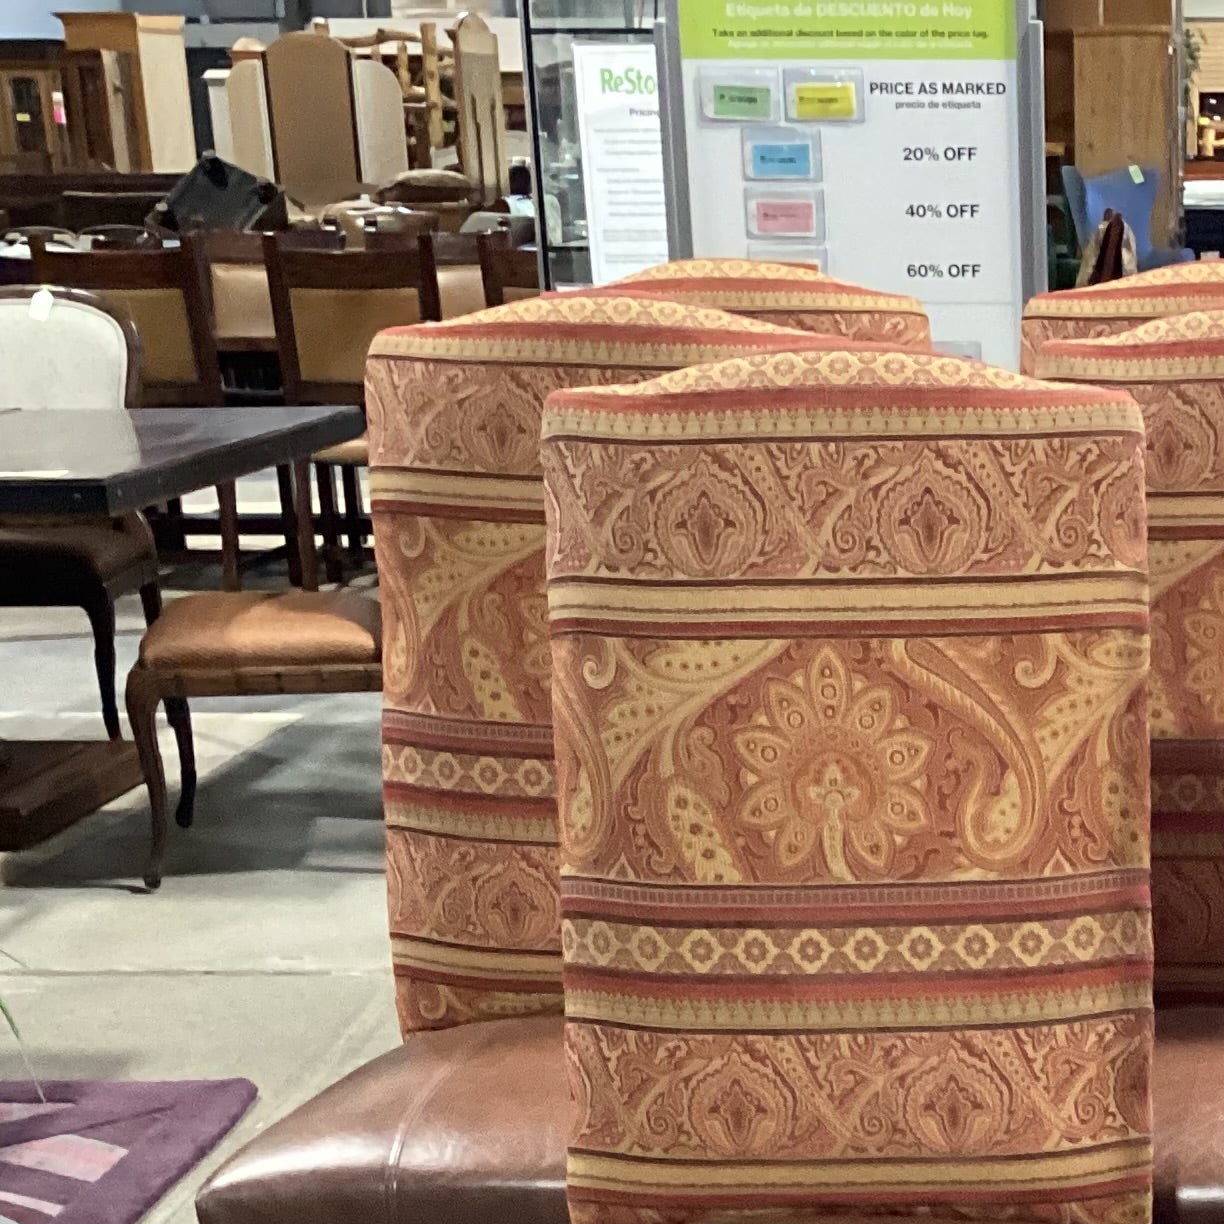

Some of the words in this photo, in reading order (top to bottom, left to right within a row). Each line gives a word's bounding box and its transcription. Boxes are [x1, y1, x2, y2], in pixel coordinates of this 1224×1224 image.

[726, 2, 790, 20] Etiqueta
[793, 2, 812, 16] de
[816, 1, 917, 17] DESCUENTO
[920, 3, 938, 16] de
[942, 3, 972, 19] Hoy
[712, 28, 734, 37] Take
[749, 28, 793, 37] additional
[795, 28, 834, 37] discount
[836, 29, 864, 38] based
[878, 29, 893, 37] the
[895, 29, 917, 37] color
[919, 29, 929, 37] of
[931, 29, 945, 38] the
[947, 30, 971, 38] price
[869, 82, 914, 95] PRICE
[918, 82, 938, 95] AS
[941, 82, 1006, 95] MARKED
[895, 101, 925, 110] precio
[927, 100, 939, 109] de
[941, 101, 981, 110] etiqueta
[903, 147, 940, 161] 20%
[943, 147, 977, 161] OFF
[905, 204, 942, 218] 40%
[946, 204, 980, 218] OFF
[907, 264, 944, 278] 60%
[948, 264, 981, 278] OFF
